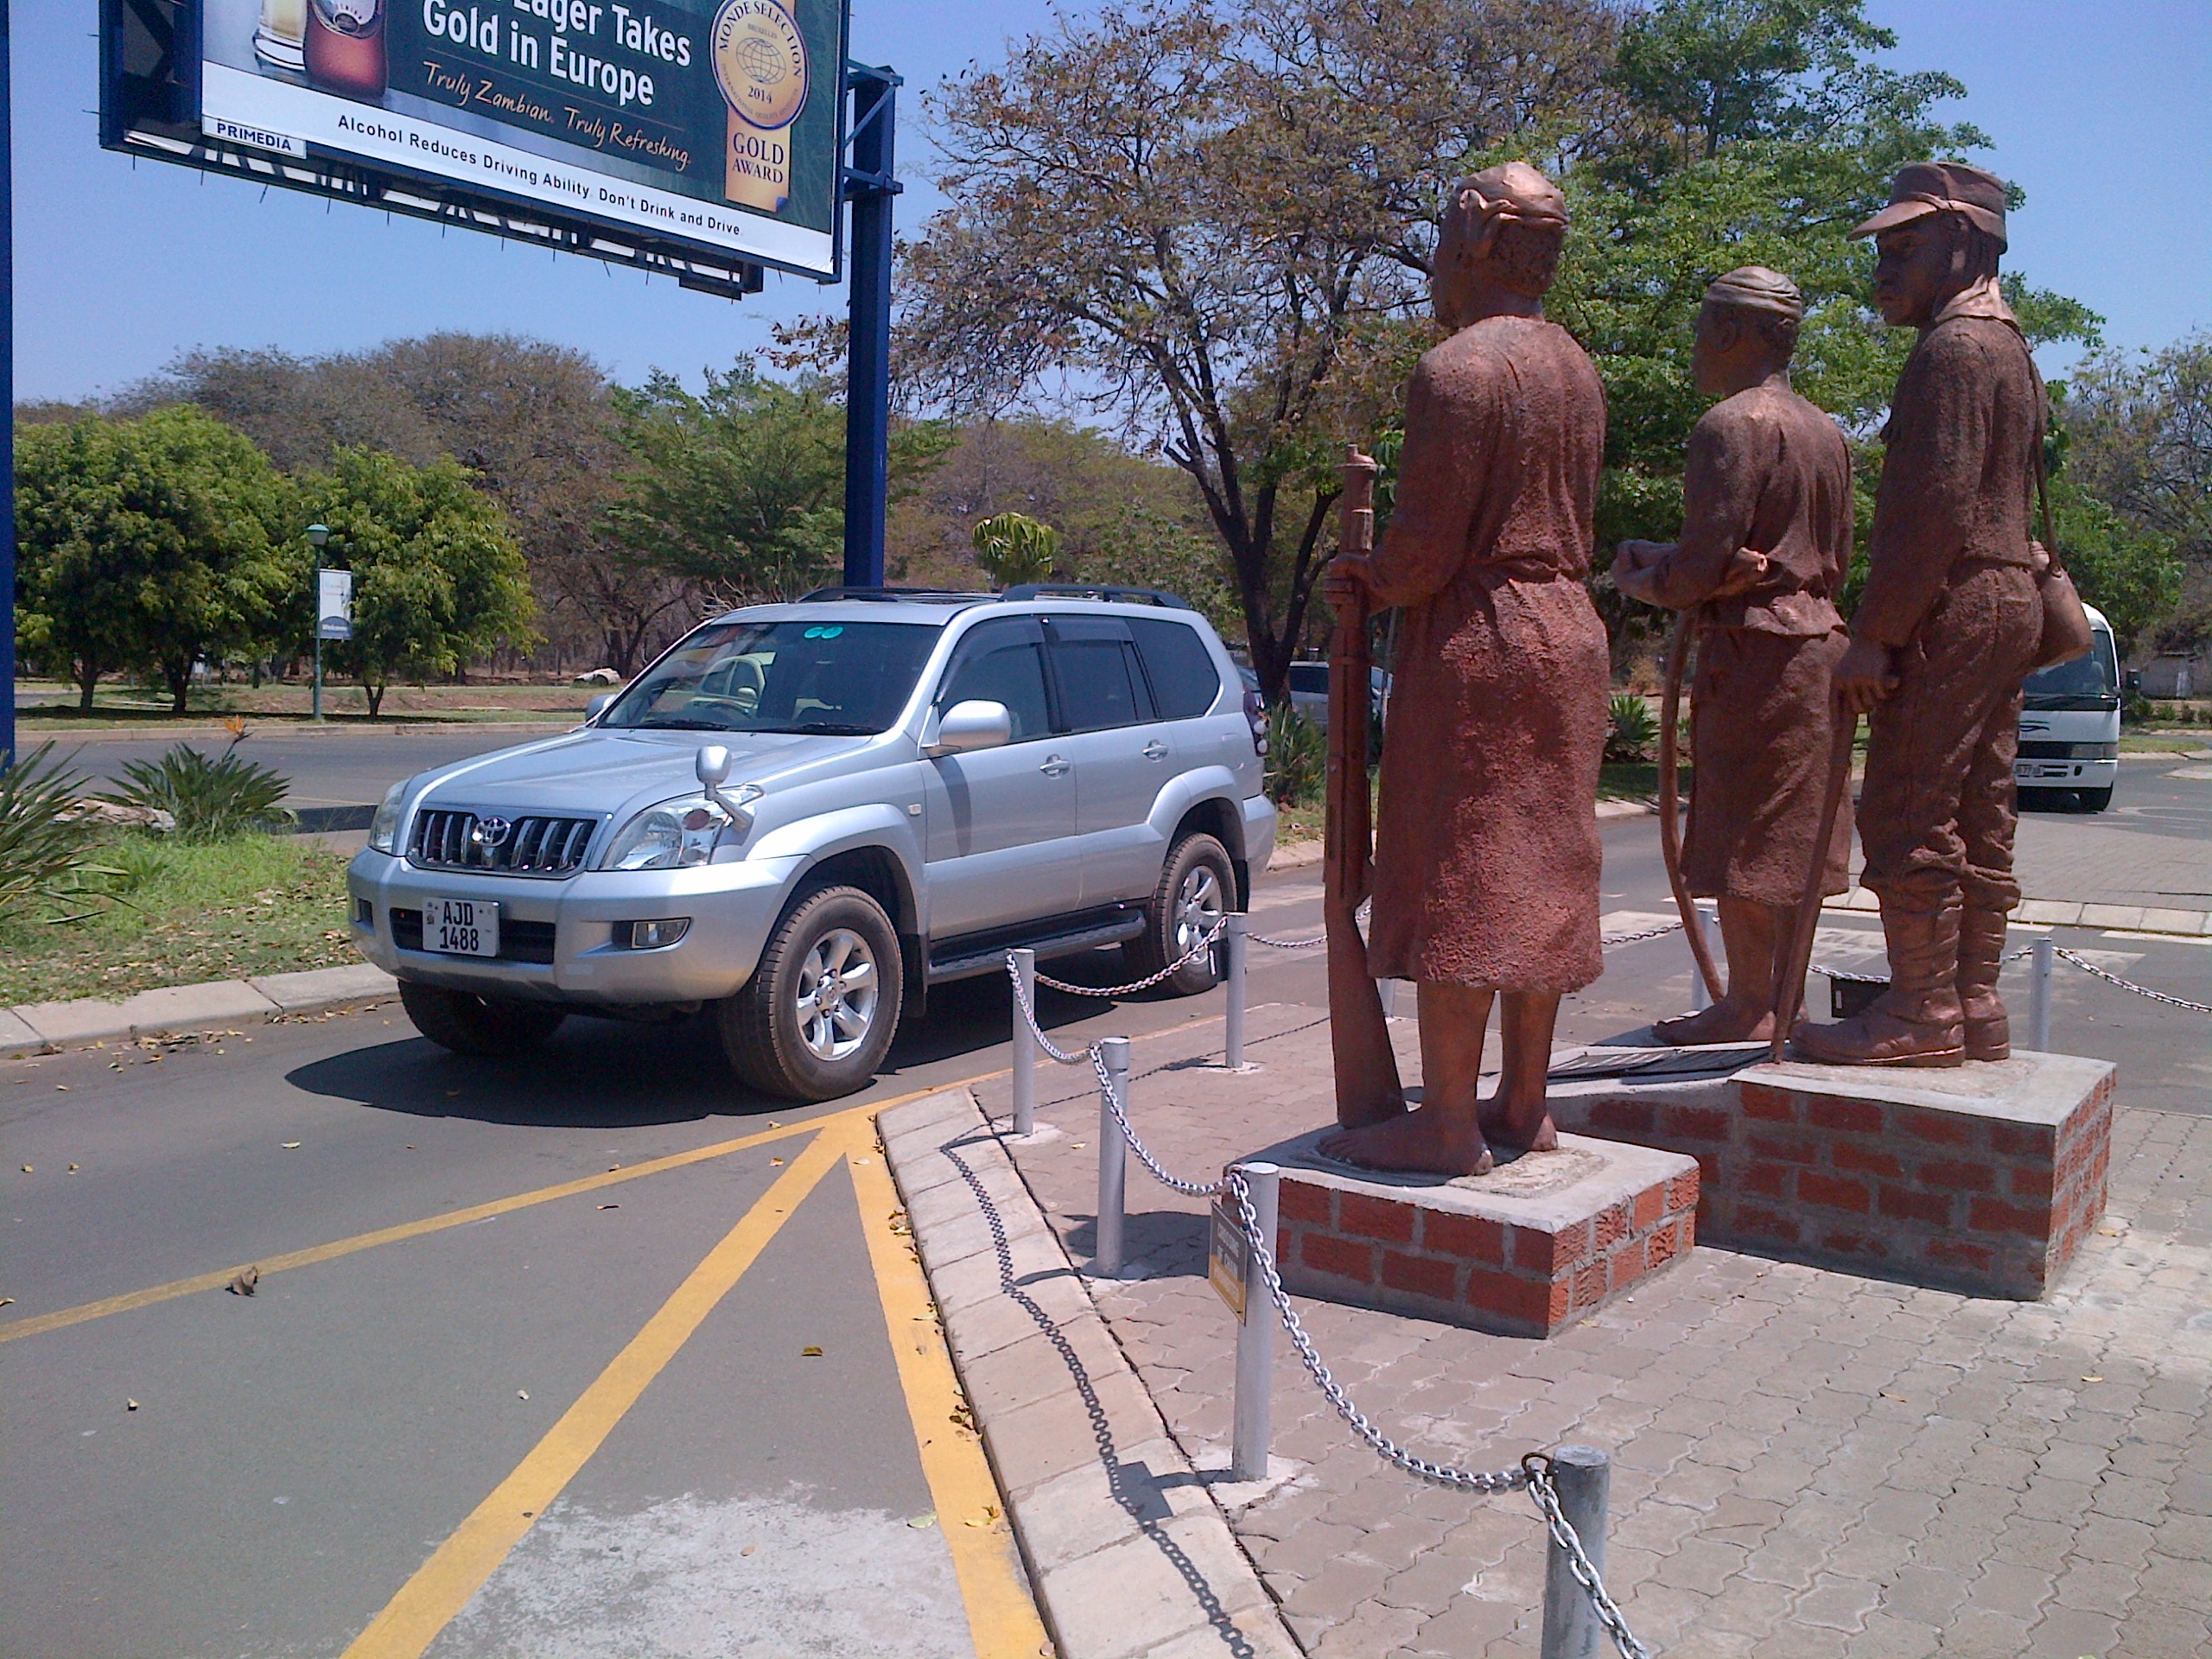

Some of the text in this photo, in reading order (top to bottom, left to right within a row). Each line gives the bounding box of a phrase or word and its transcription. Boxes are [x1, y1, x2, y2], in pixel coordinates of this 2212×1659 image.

[513, 0, 691, 67] ager Takes
[719, 1, 802, 78] MONDE SELECTION
[423, 0, 654, 106] Gold in Europe
[748, 86, 772, 104] 2014
[423, 61, 691, 172] Truly Zambian. Truly Refreshing.
[217, 123, 291, 151] PRIMEDIA
[733, 132, 784, 165] GOLD
[338, 115, 402, 143] Alcohol
[410, 133, 476, 164] Reduces
[484, 156, 537, 185] Driving
[599, 188, 635, 209] Don't
[641, 200, 675, 219] Drink
[680, 212, 702, 226] and
[733, 158, 783, 183] AWARD
[443, 901, 474, 925] AJD
[439, 926, 479, 951] 1488
